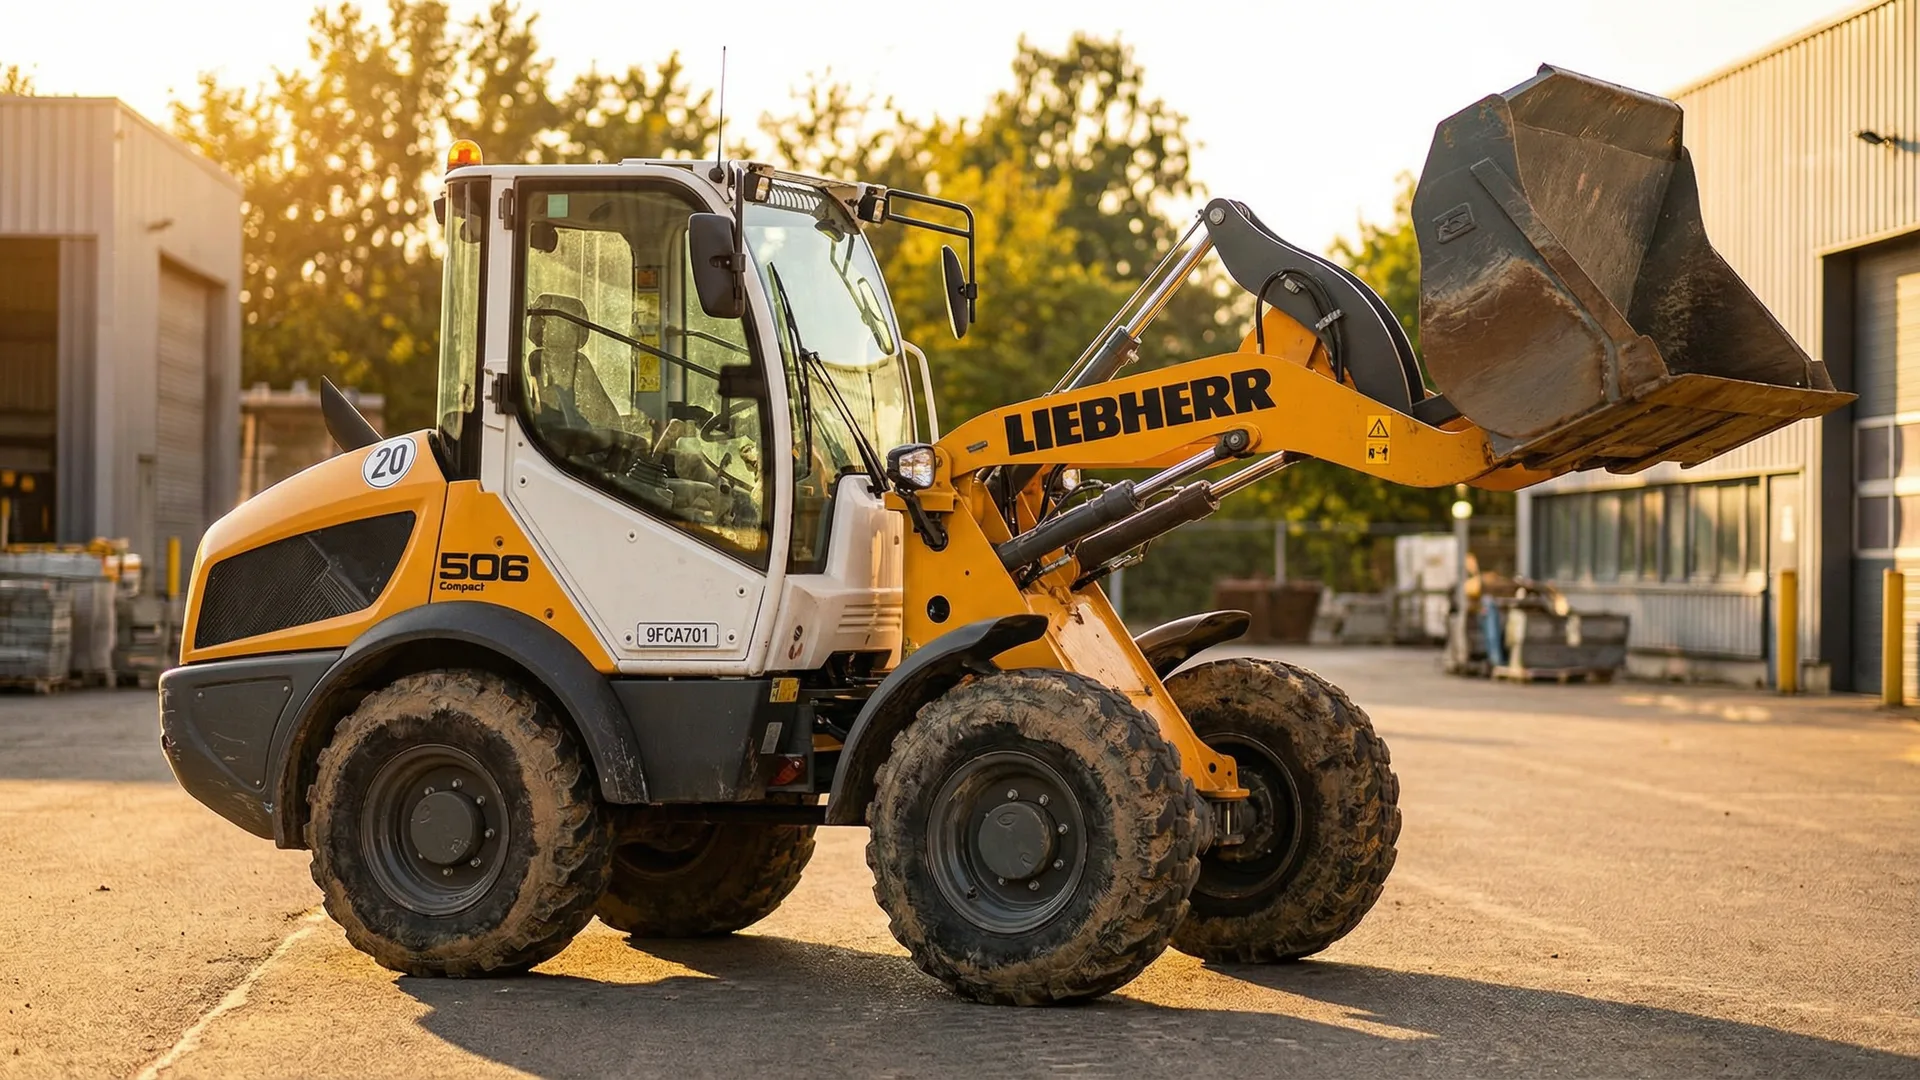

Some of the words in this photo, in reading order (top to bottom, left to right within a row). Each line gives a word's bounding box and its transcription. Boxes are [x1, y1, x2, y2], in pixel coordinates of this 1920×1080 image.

[1004, 369, 1276, 455] LIEBHERR
[371, 443, 408, 479] 20
[440, 553, 529, 581] 506
[440, 582, 484, 593] Compact
[646, 627, 708, 643] 9FCA701
